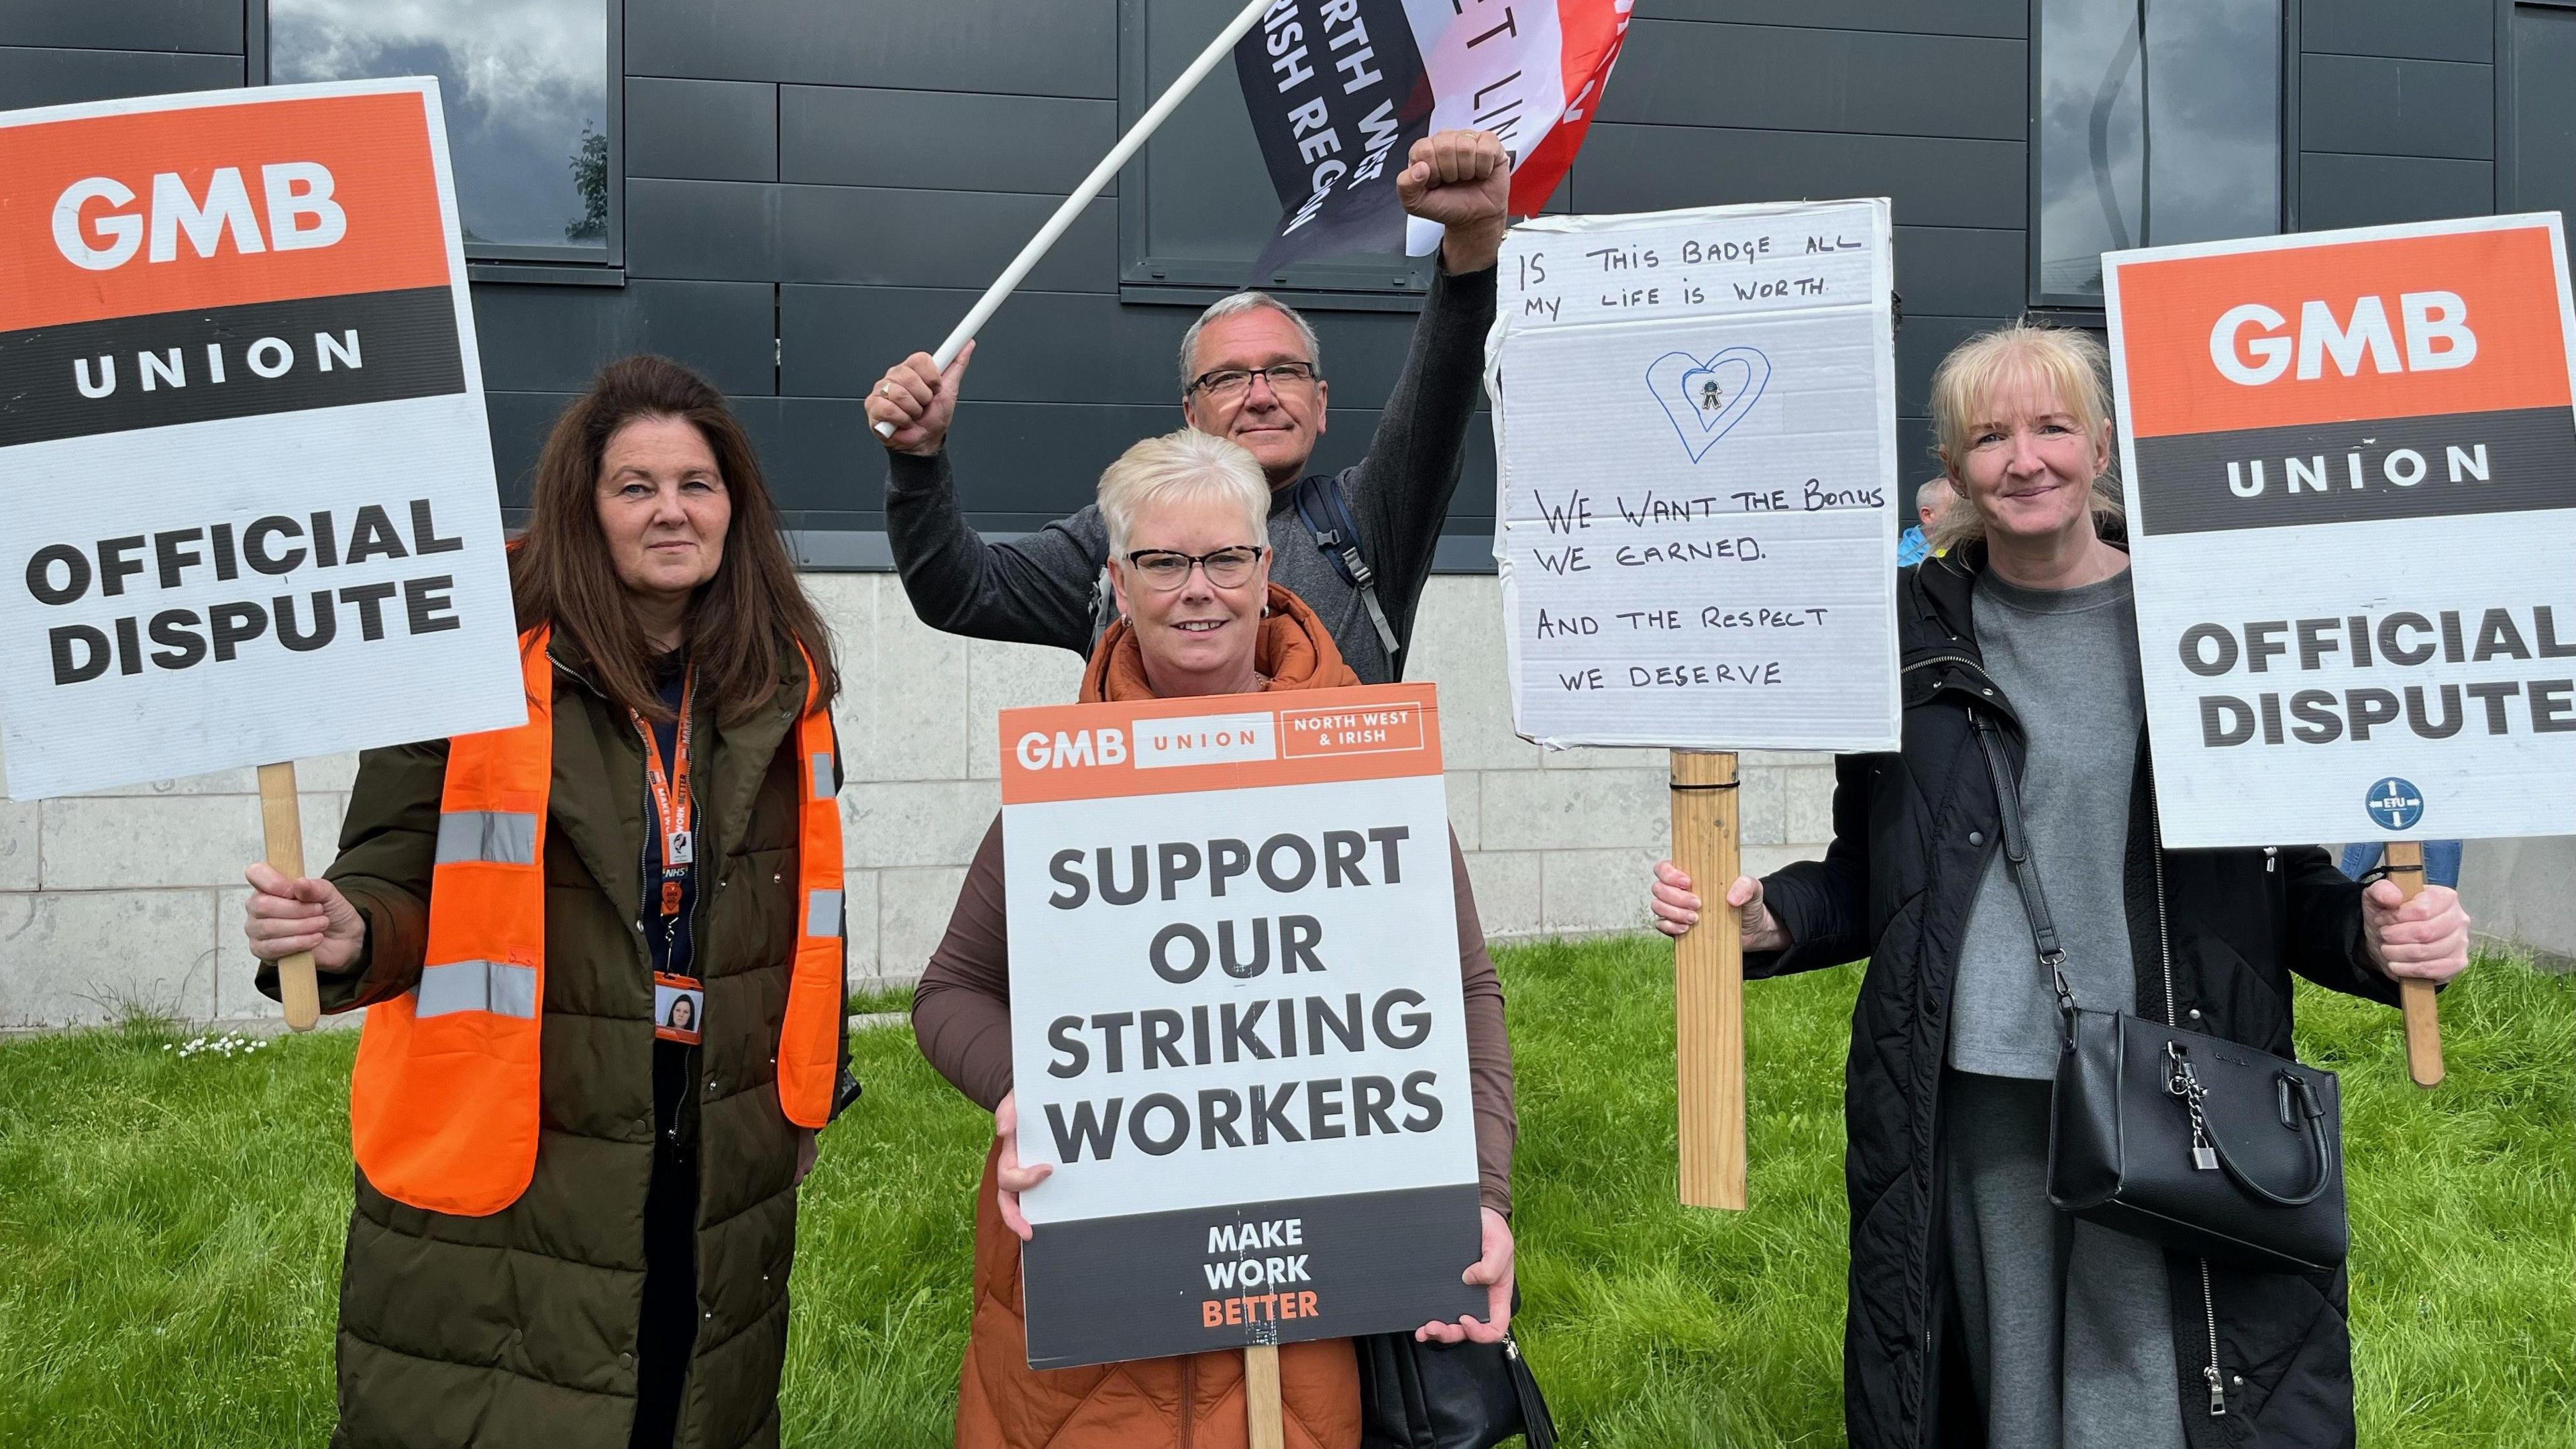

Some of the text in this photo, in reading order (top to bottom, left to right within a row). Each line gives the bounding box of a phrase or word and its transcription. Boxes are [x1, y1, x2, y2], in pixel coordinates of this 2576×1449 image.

[1348, 99, 1399, 190] WEST
[1473, 70, 1523, 174] LIN
[52, 162, 347, 270] GMB
[1520, 252, 1545, 291] IS
[1683, 236, 1769, 264] BADGE
[1806, 235, 1862, 254] ALL
[1525, 297, 1560, 321] MY
[74, 329, 362, 398] UNION
[2210, 291, 2477, 386] GMB
[2227, 444, 2490, 497] UNION
[1534, 489, 1592, 534] WE
[1617, 490, 1717, 527] WANT
[1731, 490, 1789, 511] THE
[26, 499, 464, 605] OFFICIAL
[1533, 537, 1766, 576] WE EARNED.
[49, 575, 460, 686] DISPUTE
[1538, 608, 1599, 639] AND
[1616, 610, 1681, 629] THE
[2179, 606, 2576, 677] OFFICIAL
[1559, 661, 1782, 691] WE DESERVE
[1294, 711, 1409, 731] NORTH WEST
[1320, 729, 1386, 746] & IRISH
[2199, 680, 2575, 747] DISPUTE
[1016, 729, 1254, 771] GMB UNION
[657, 788, 670, 815] MAKE
[665, 868, 686, 877] NHS
[1048, 826, 1409, 910] SUPPORT
[1149, 914, 1327, 983] OUR
[1046, 987, 1432, 1079] STRIKING
[1043, 1069, 1443, 1164] WORKERS
[1208, 1218, 1303, 1254] MAKE
[1203, 1254, 1311, 1290] WORK
[1202, 1290, 1320, 1328] BETTER
